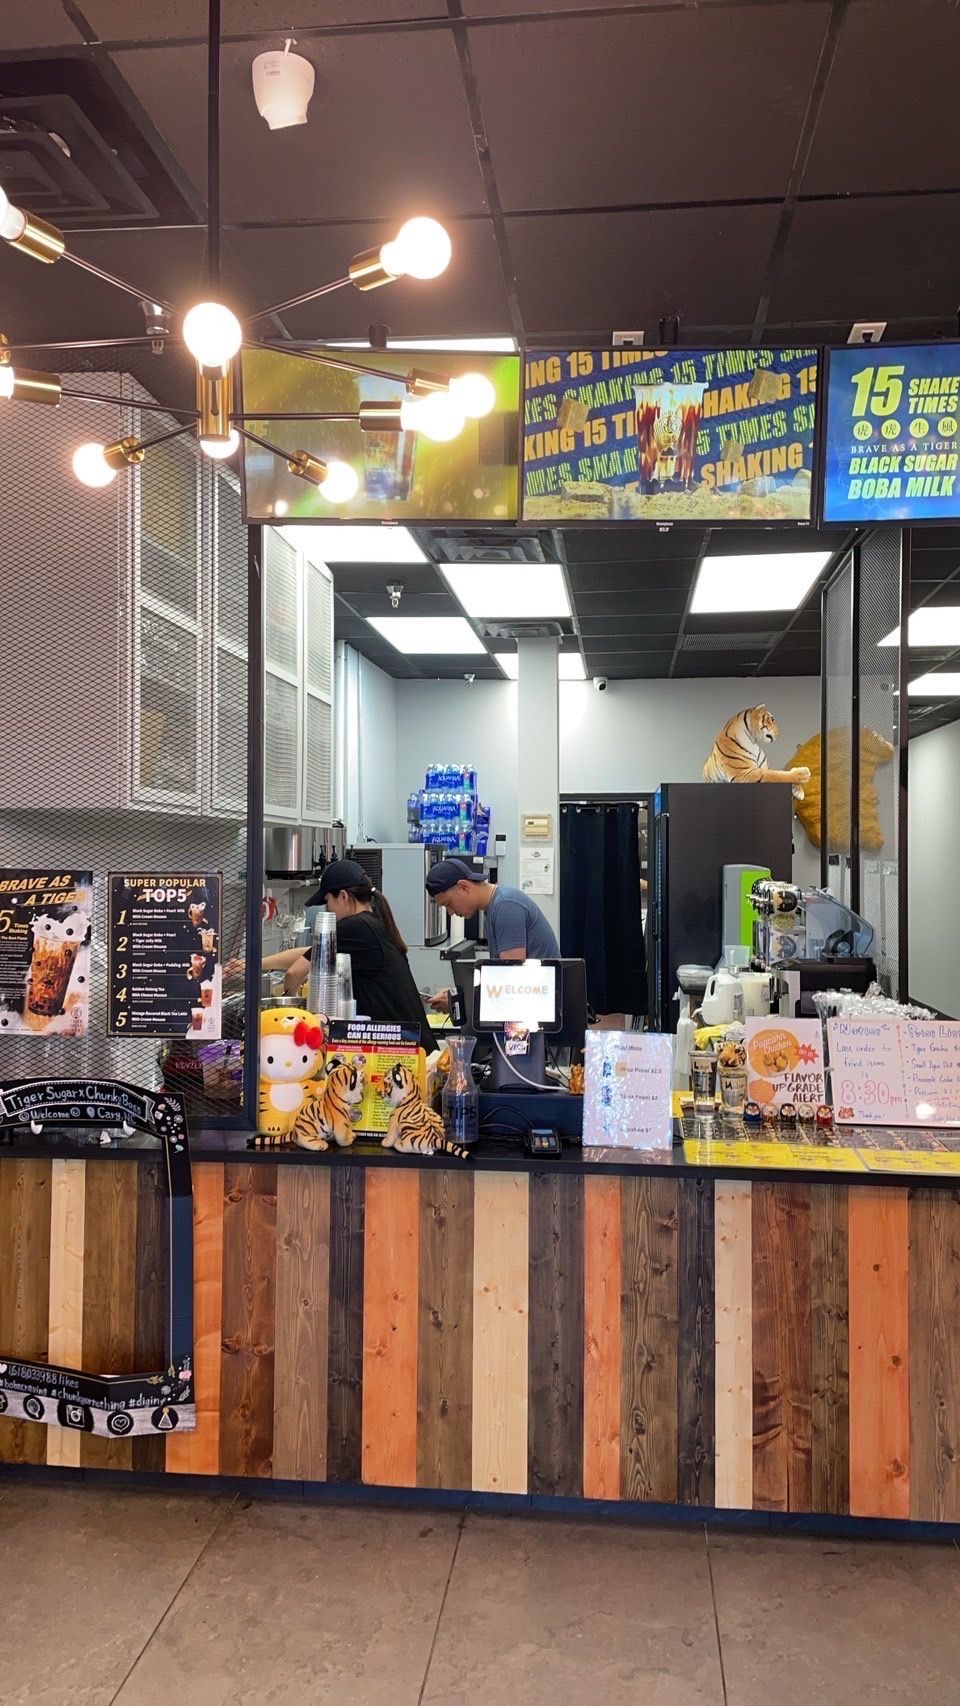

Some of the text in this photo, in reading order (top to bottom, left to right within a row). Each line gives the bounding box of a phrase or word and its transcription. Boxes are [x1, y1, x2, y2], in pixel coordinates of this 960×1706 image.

[566, 351, 594, 378] 15
[851, 365, 960, 417] 15 SHAKE
[908, 395, 959, 415] TIMES
[583, 417, 607, 447] 15
[850, 443, 888, 454] BRAVE
[892, 443, 906, 453] AS
[910, 442, 918, 452] A
[701, 443, 803, 489] SHAKING
[848, 453, 959, 475] BLACK SUGAR
[847, 475, 956, 500] BOBA MILK
[0, 874, 72, 892] BRAVE AS
[123, 878, 206, 889] SUPER POPULAR
[24, 890, 86, 906] A TIGER
[143, 888, 187, 903] TOP5
[116, 909, 127, 925] 1
[116, 936, 128, 952] 2
[116, 963, 128, 979] 3
[116, 987, 127, 1002] 4
[486, 984, 549, 999] WELCOME
[115, 1011, 128, 1027] 5
[347, 1023, 402, 1033] FOOD ALLERGIES
[372, 1033, 402, 1041] SERIOUS
[753, 1033, 786, 1050] Popcorn
[784, 1072, 824, 1083] FLAVOR
[772, 1082, 825, 1093] UPGRADE
[4, 1092, 45, 1110] Tiger
[45, 1085, 78, 1102] Sugar
[85, 1085, 122, 1107] Chunky
[120, 1092, 142, 1116] Boss
[792, 1093, 825, 1103] ALERT
[30, 1107, 71, 1120] Welcome
[123, 1111, 137, 1125] NC
[447, 1105, 477, 1119] TIPS
[58, 1373, 80, 1389] likes
